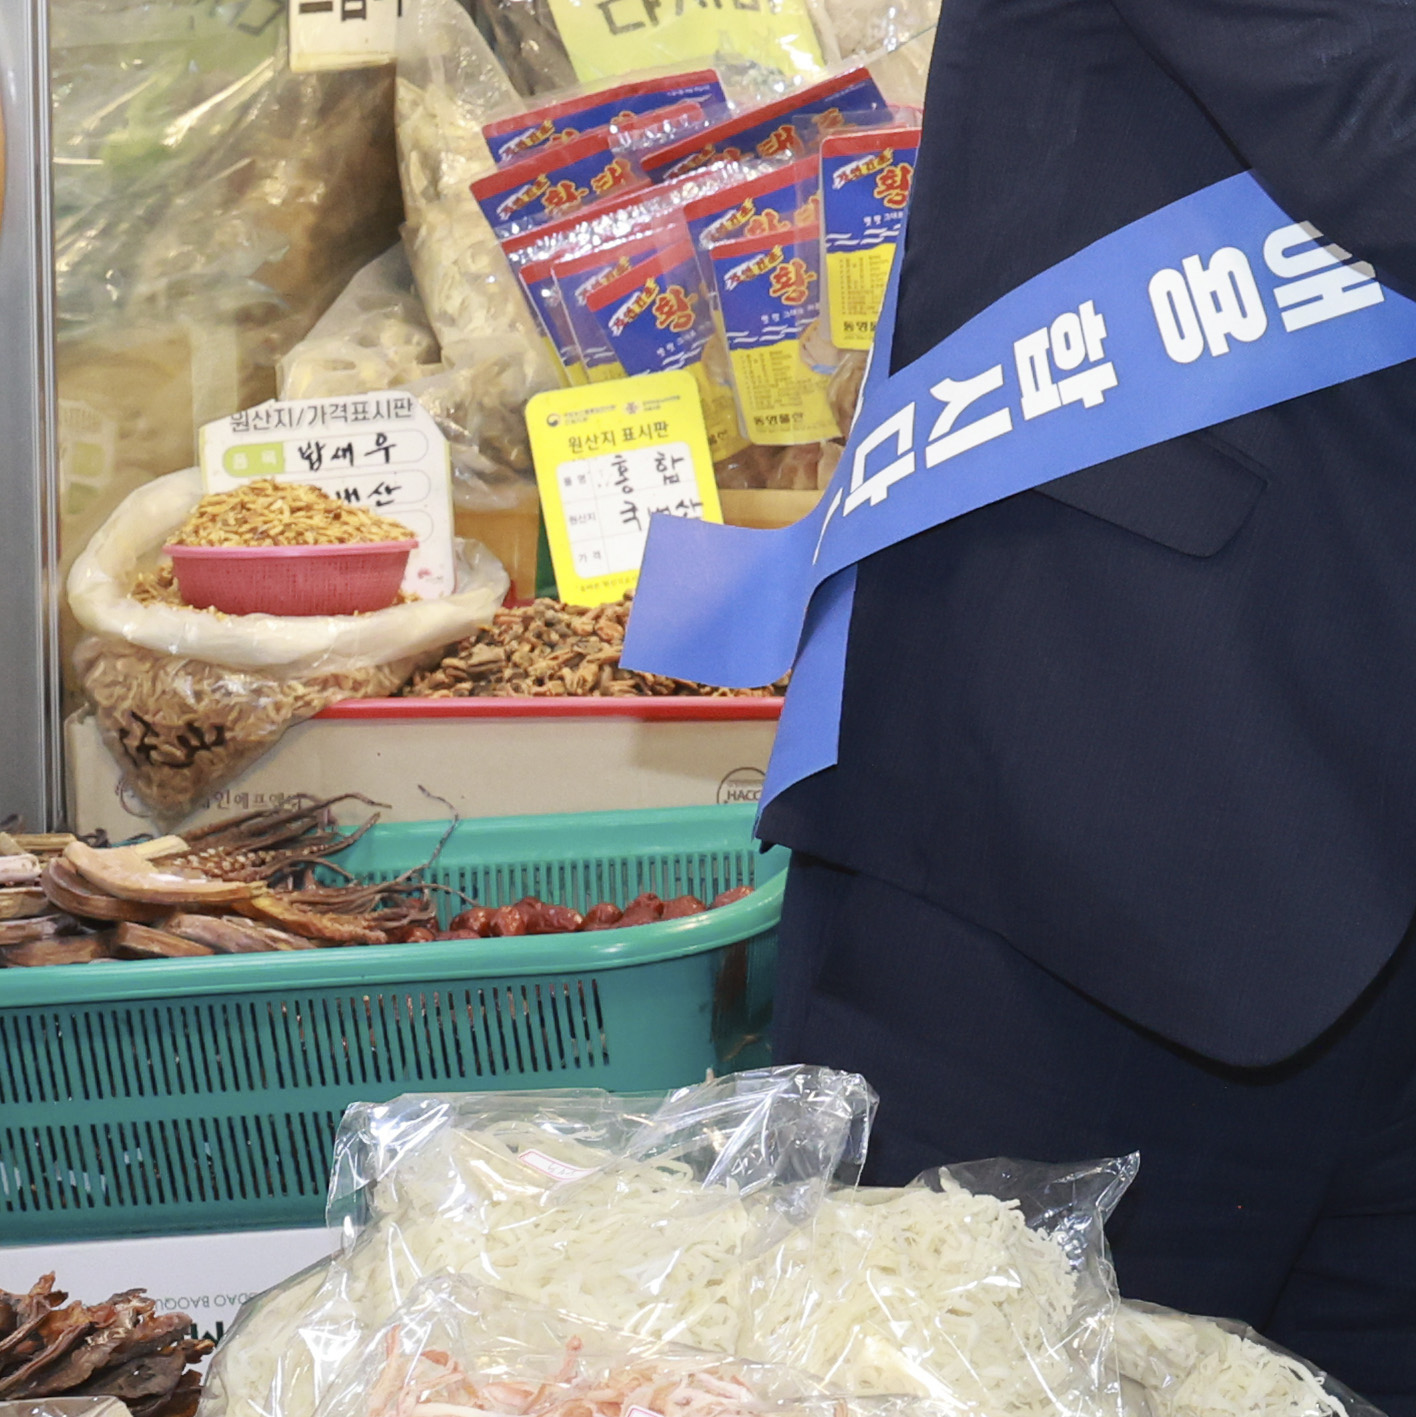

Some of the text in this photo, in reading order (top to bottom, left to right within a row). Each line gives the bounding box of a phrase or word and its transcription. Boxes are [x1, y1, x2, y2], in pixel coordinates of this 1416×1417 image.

[1147, 220, 1385, 365] 애용
[230, 397, 413, 433] 원산지/가격표시판
[811, 299, 1119, 565] 합시다
[568, 421, 669, 454] 원산지 표시판
[611, 452, 685, 494] 홍합
